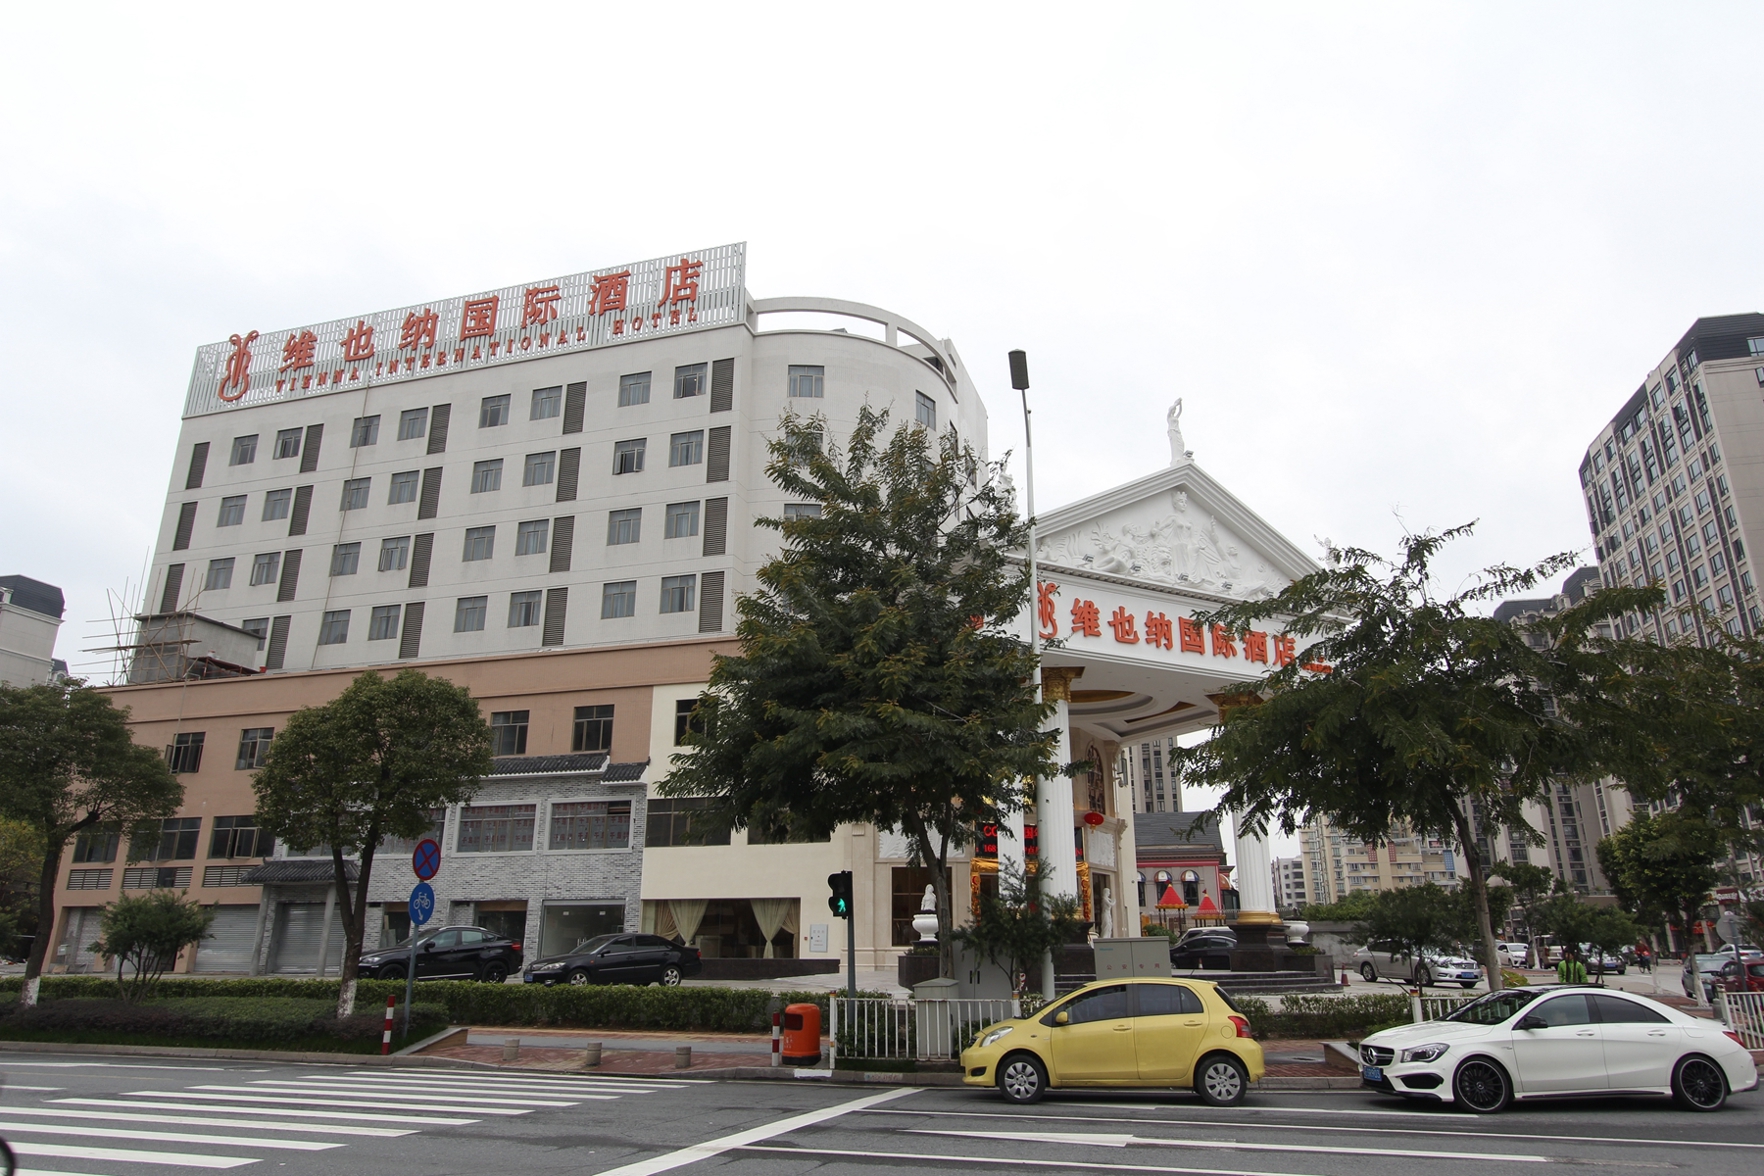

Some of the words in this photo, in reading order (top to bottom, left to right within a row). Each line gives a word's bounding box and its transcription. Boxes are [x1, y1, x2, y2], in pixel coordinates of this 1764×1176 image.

[276, 366, 359, 392] VIENNA
[375, 326, 587, 376] INTERNATIONAL
[613, 306, 698, 335] HOTEL
[279, 258, 703, 373] 维也纳国际酒店
[1071, 597, 1297, 668] 维也纳国际酒店
